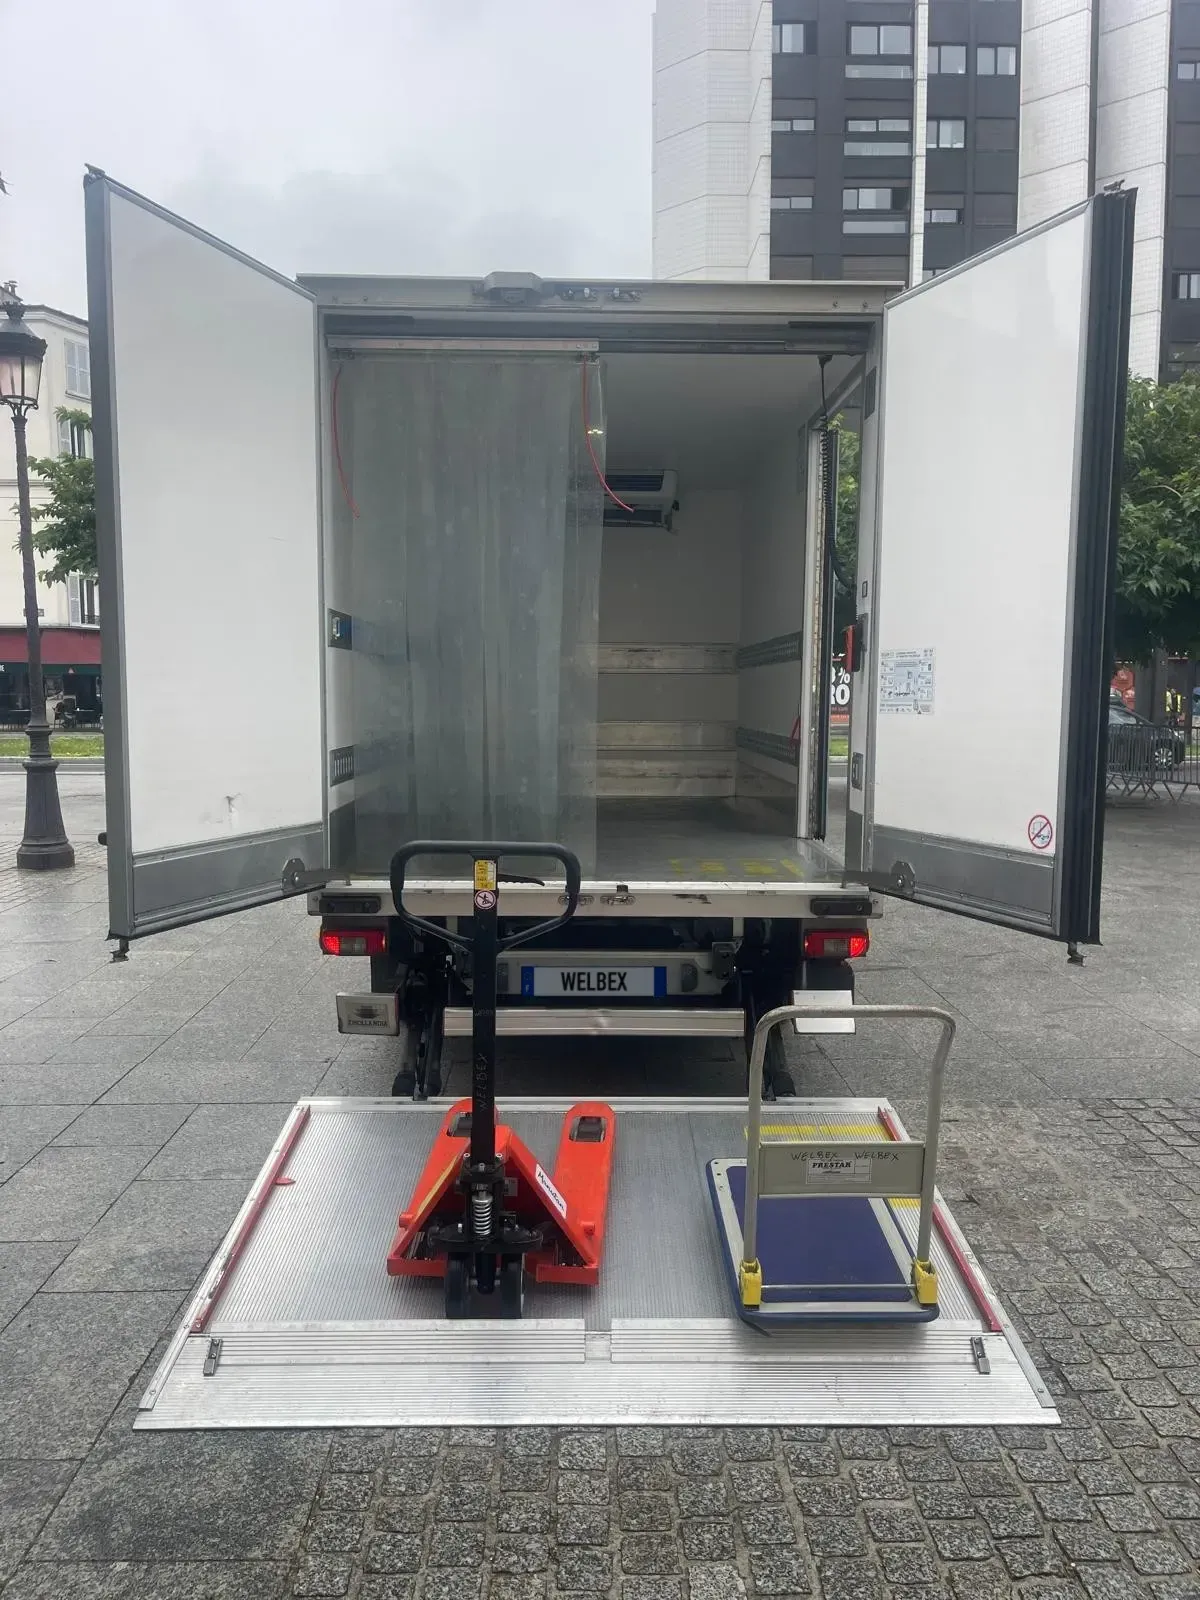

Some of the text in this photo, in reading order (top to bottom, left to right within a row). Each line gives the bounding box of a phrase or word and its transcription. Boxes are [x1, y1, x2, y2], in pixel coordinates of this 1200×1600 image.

[561, 972, 627, 991] WELBEX
[475, 1052, 489, 1112] WELBEX
[790, 1150, 900, 1162] WELBEX WELBEX
